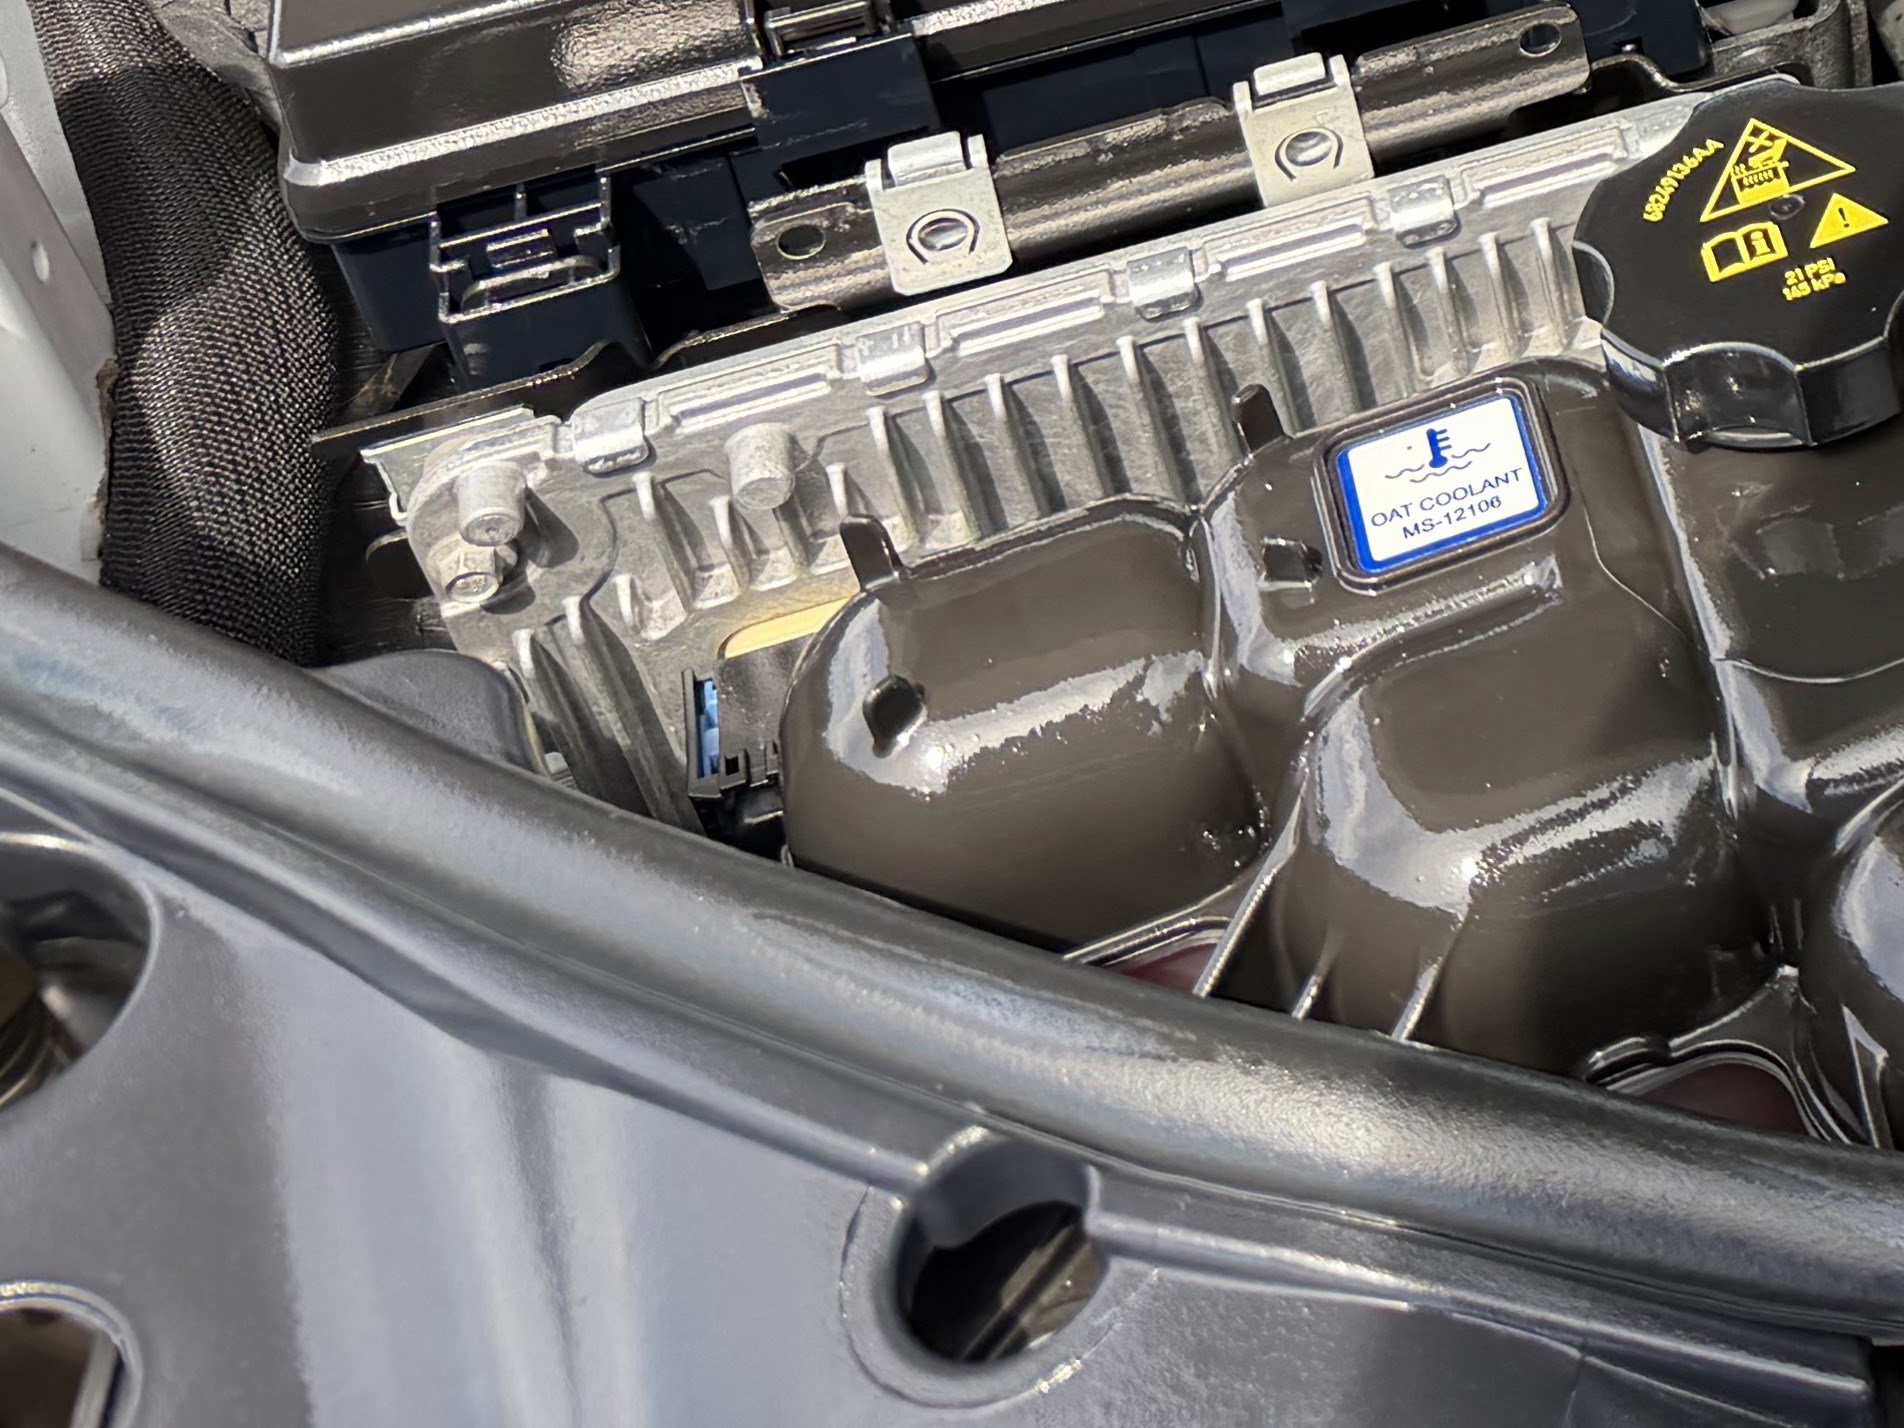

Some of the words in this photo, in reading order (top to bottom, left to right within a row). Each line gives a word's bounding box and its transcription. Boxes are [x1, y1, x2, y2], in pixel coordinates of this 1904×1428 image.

[1784, 267, 1805, 286] 21
[1804, 257, 1835, 280] PSI
[1370, 502, 1414, 527] OAT
[1420, 467, 1523, 511] COOLANT
[1402, 495, 1502, 539] MS-12106
